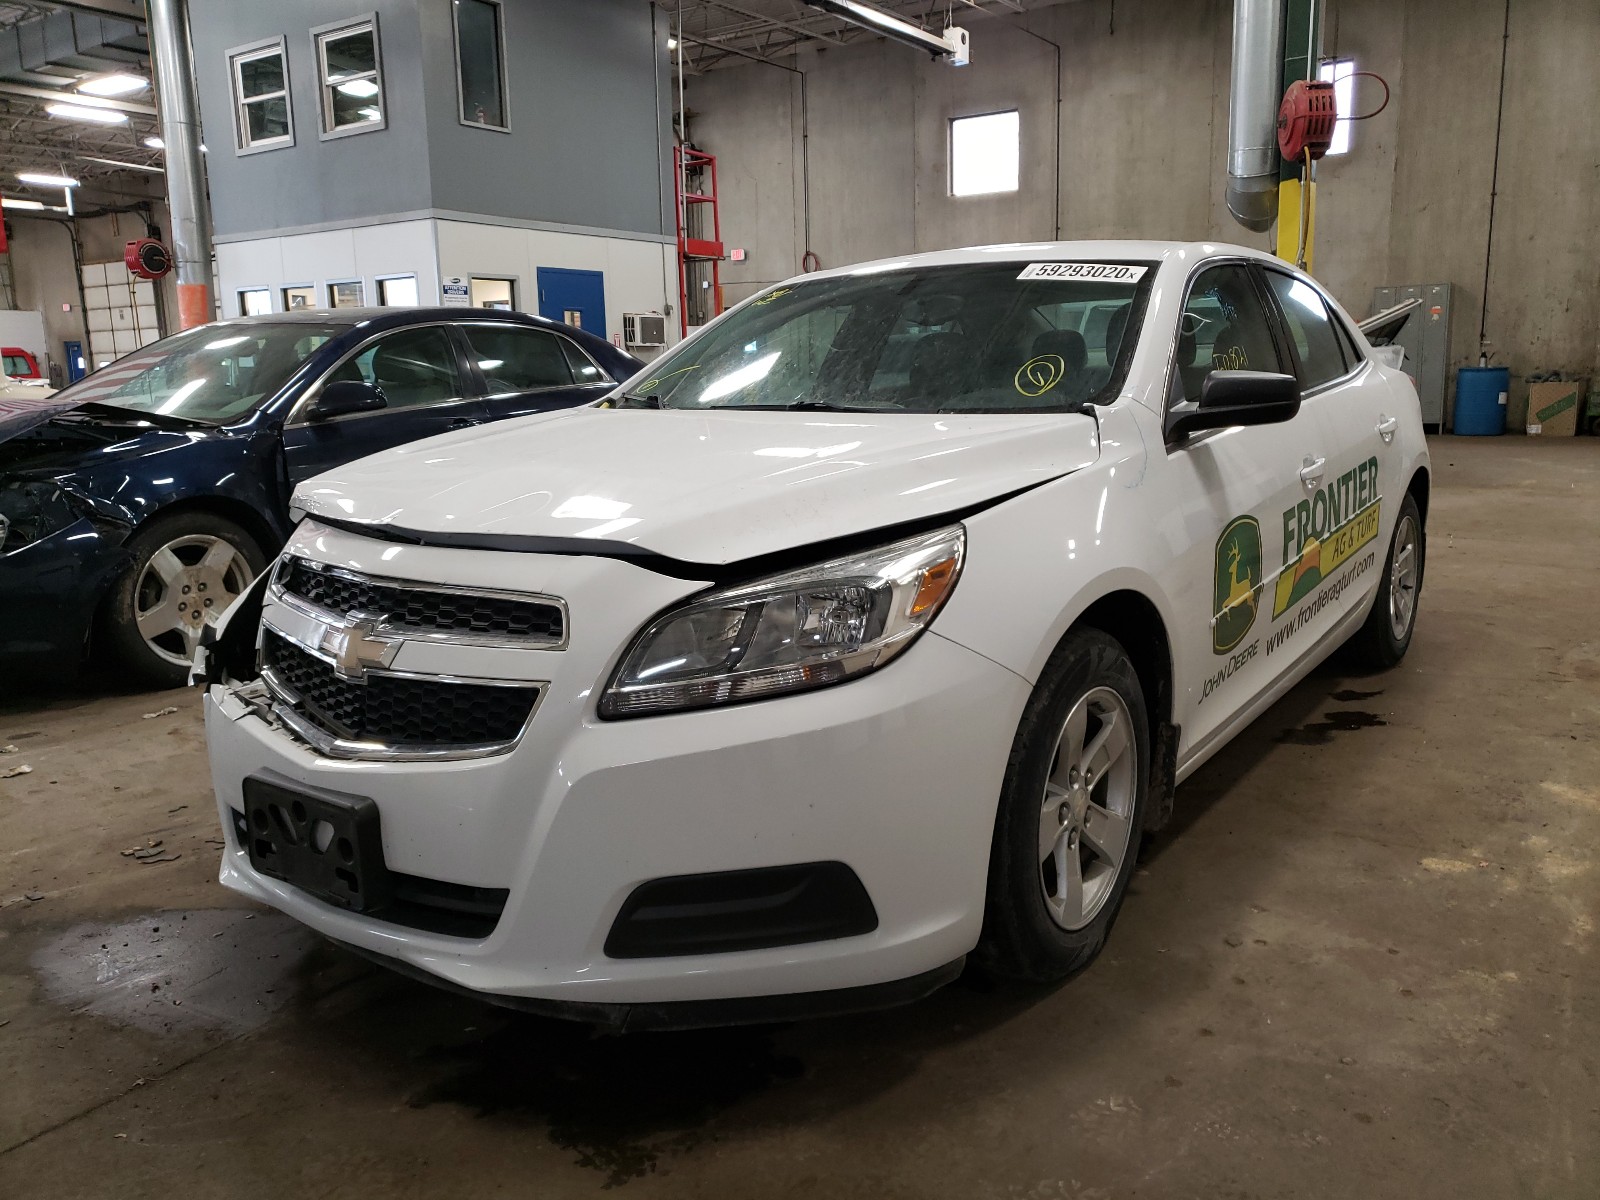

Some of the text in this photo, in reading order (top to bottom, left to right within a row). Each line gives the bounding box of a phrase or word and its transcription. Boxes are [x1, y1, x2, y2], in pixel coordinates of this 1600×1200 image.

[1283, 456, 1378, 566] FRONTIER
[1332, 509, 1377, 562] AG & TURF
[1266, 552, 1375, 656] www.frontieragturf.com
[1198, 639, 1260, 705] JOHN DEERE
